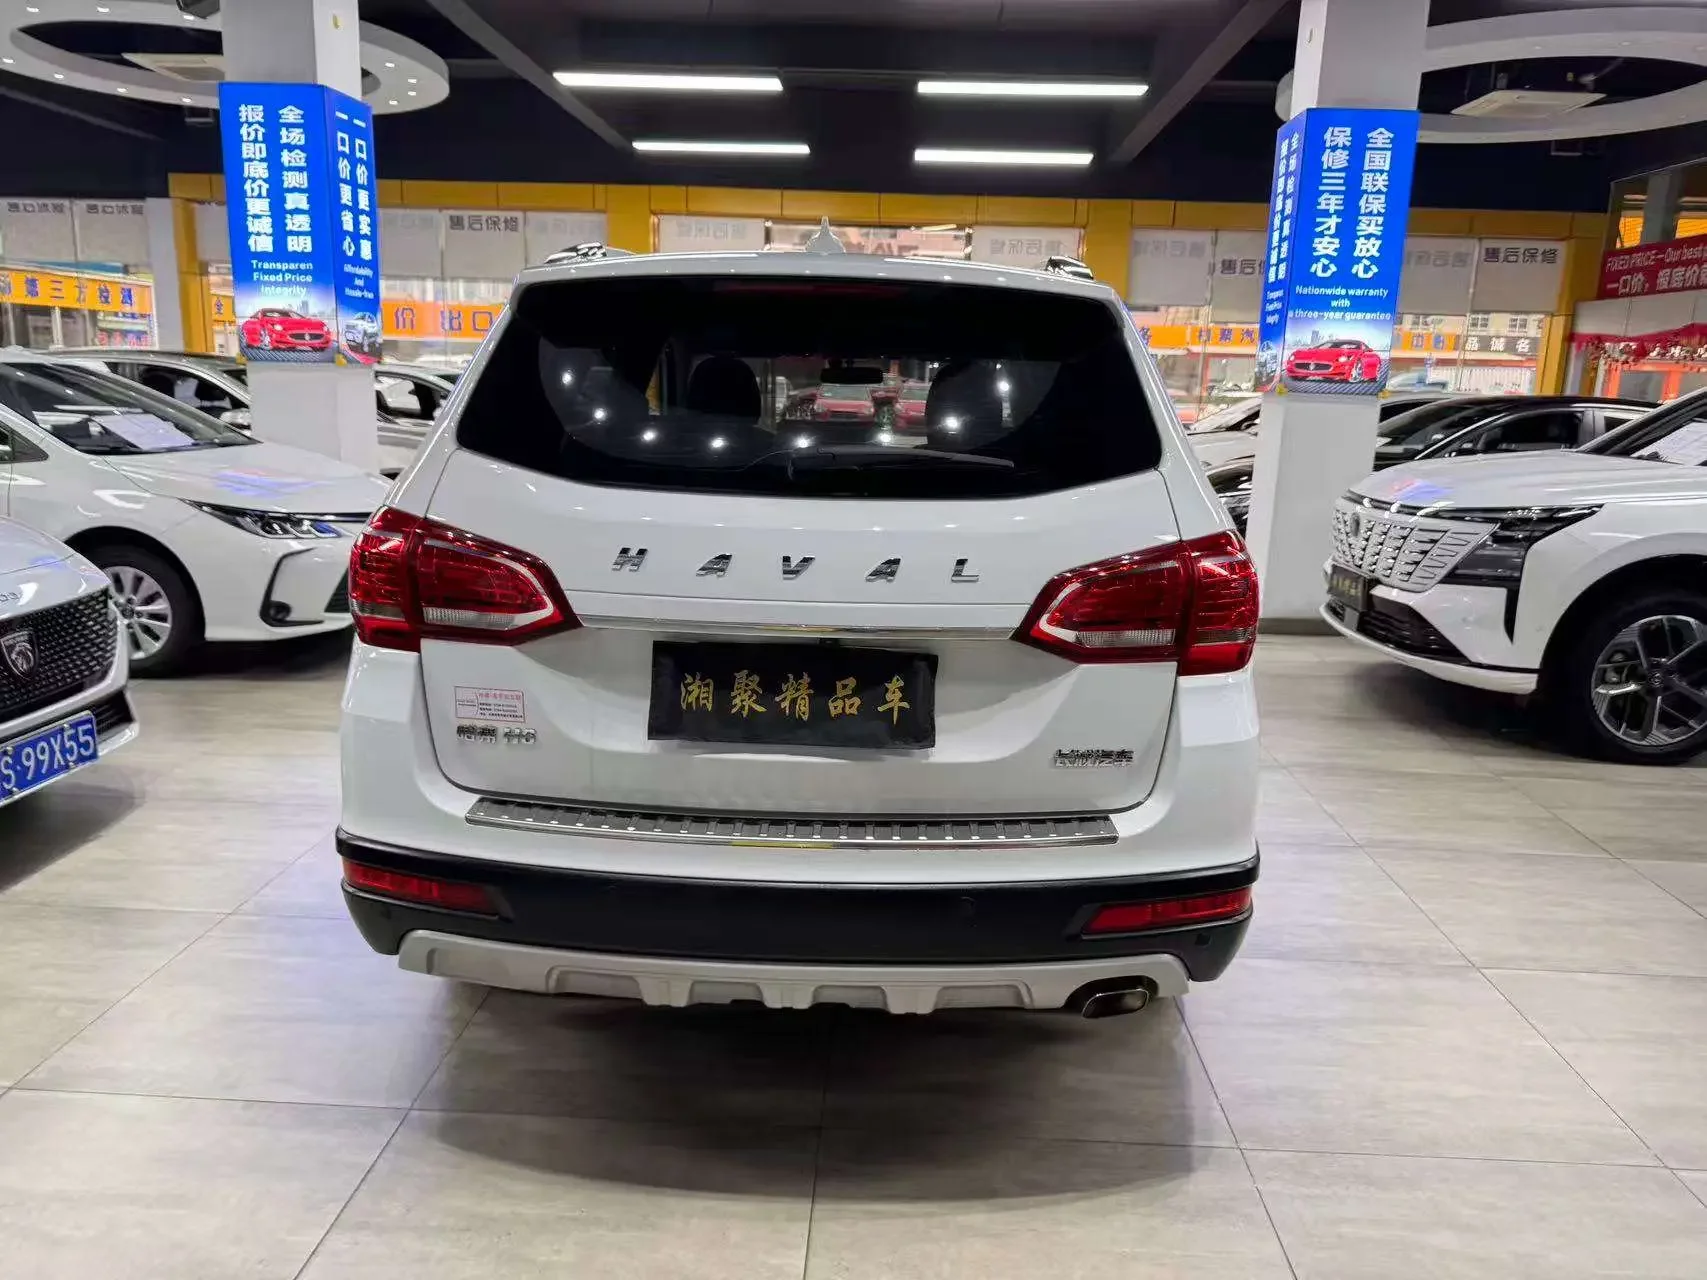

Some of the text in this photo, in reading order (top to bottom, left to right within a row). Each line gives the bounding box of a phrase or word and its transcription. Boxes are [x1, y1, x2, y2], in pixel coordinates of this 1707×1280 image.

[279, 105, 313, 253] 全场检测真透明
[335, 110, 356, 257] 一口价更省心
[352, 118, 373, 261] 一口价更实惠
[1309, 126, 1353, 278] 保修三年才安心
[1351, 127, 1395, 279] 全国联保买放心
[449, 215, 520, 232] 售后保修
[1483, 247, 1559, 264] 售后保修
[253, 272, 313, 283] Fixed Price
[261, 285, 308, 298] Integrity
[1295, 285, 1347, 296] Nationwide
[1348, 288, 1389, 299] warranty
[1331, 298, 1351, 308] with
[1295, 308, 1344, 320] three-year
[611, 547, 980, 584] HAVAL
[680, 669, 911, 725] 湘聚精品车
